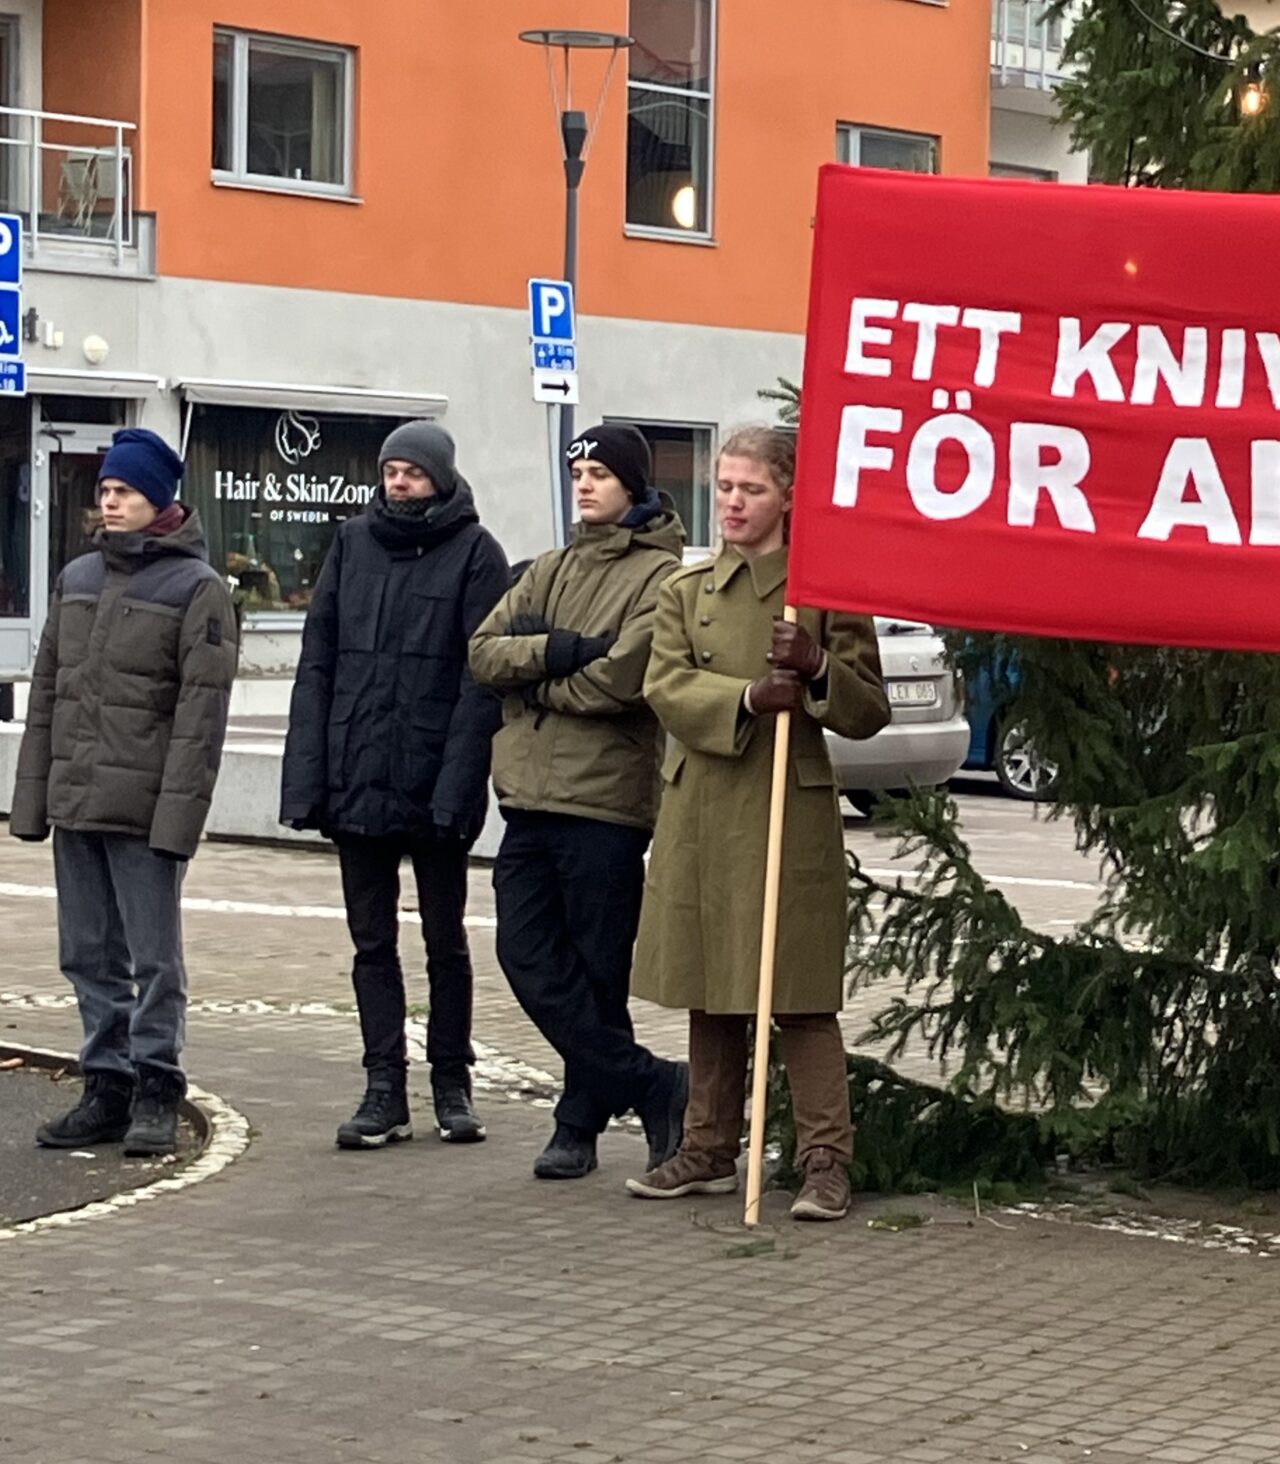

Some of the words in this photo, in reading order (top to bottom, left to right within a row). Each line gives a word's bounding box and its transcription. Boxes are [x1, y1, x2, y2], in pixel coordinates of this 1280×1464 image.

[540, 286, 566, 335] P
[844, 297, 1022, 388] ETT
[831, 388, 1096, 533] FÖR
[215, 470, 260, 500] Hair
[263, 472, 283, 501] &
[269, 509, 284, 521] OF
[287, 510, 329, 523] SWEDEN
